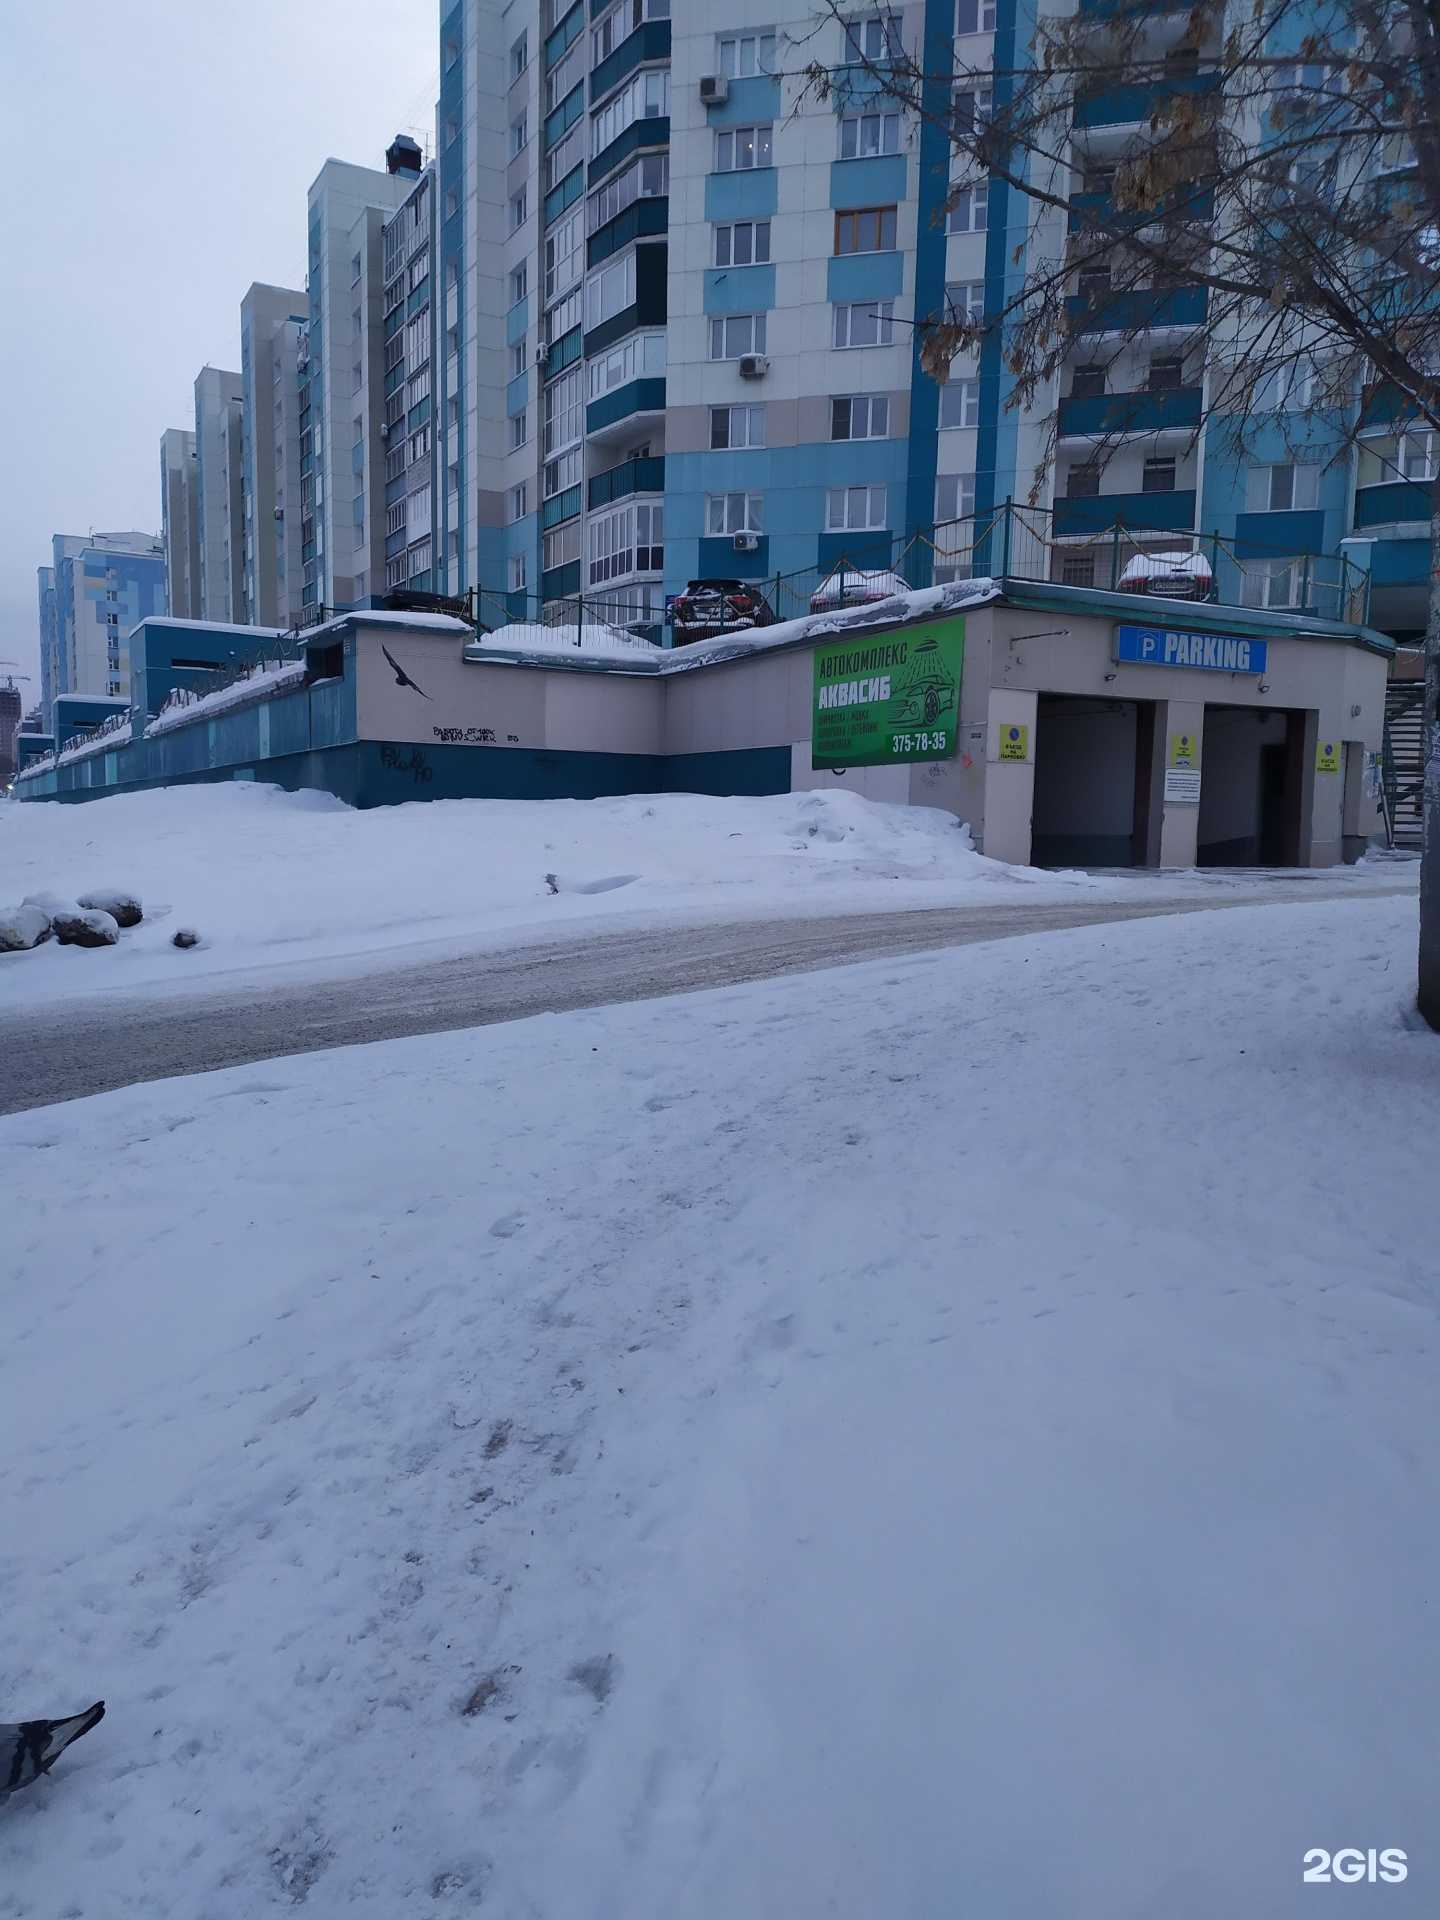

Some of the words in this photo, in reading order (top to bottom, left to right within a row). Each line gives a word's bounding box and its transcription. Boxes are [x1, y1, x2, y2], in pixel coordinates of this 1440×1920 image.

[819, 642, 909, 679] АВТОКОМПЛЕКС
[1164, 633, 1251, 670] PARKING
[818, 675, 891, 710] АКВАСИБ
[892, 731, 946, 753] 375-78-35
